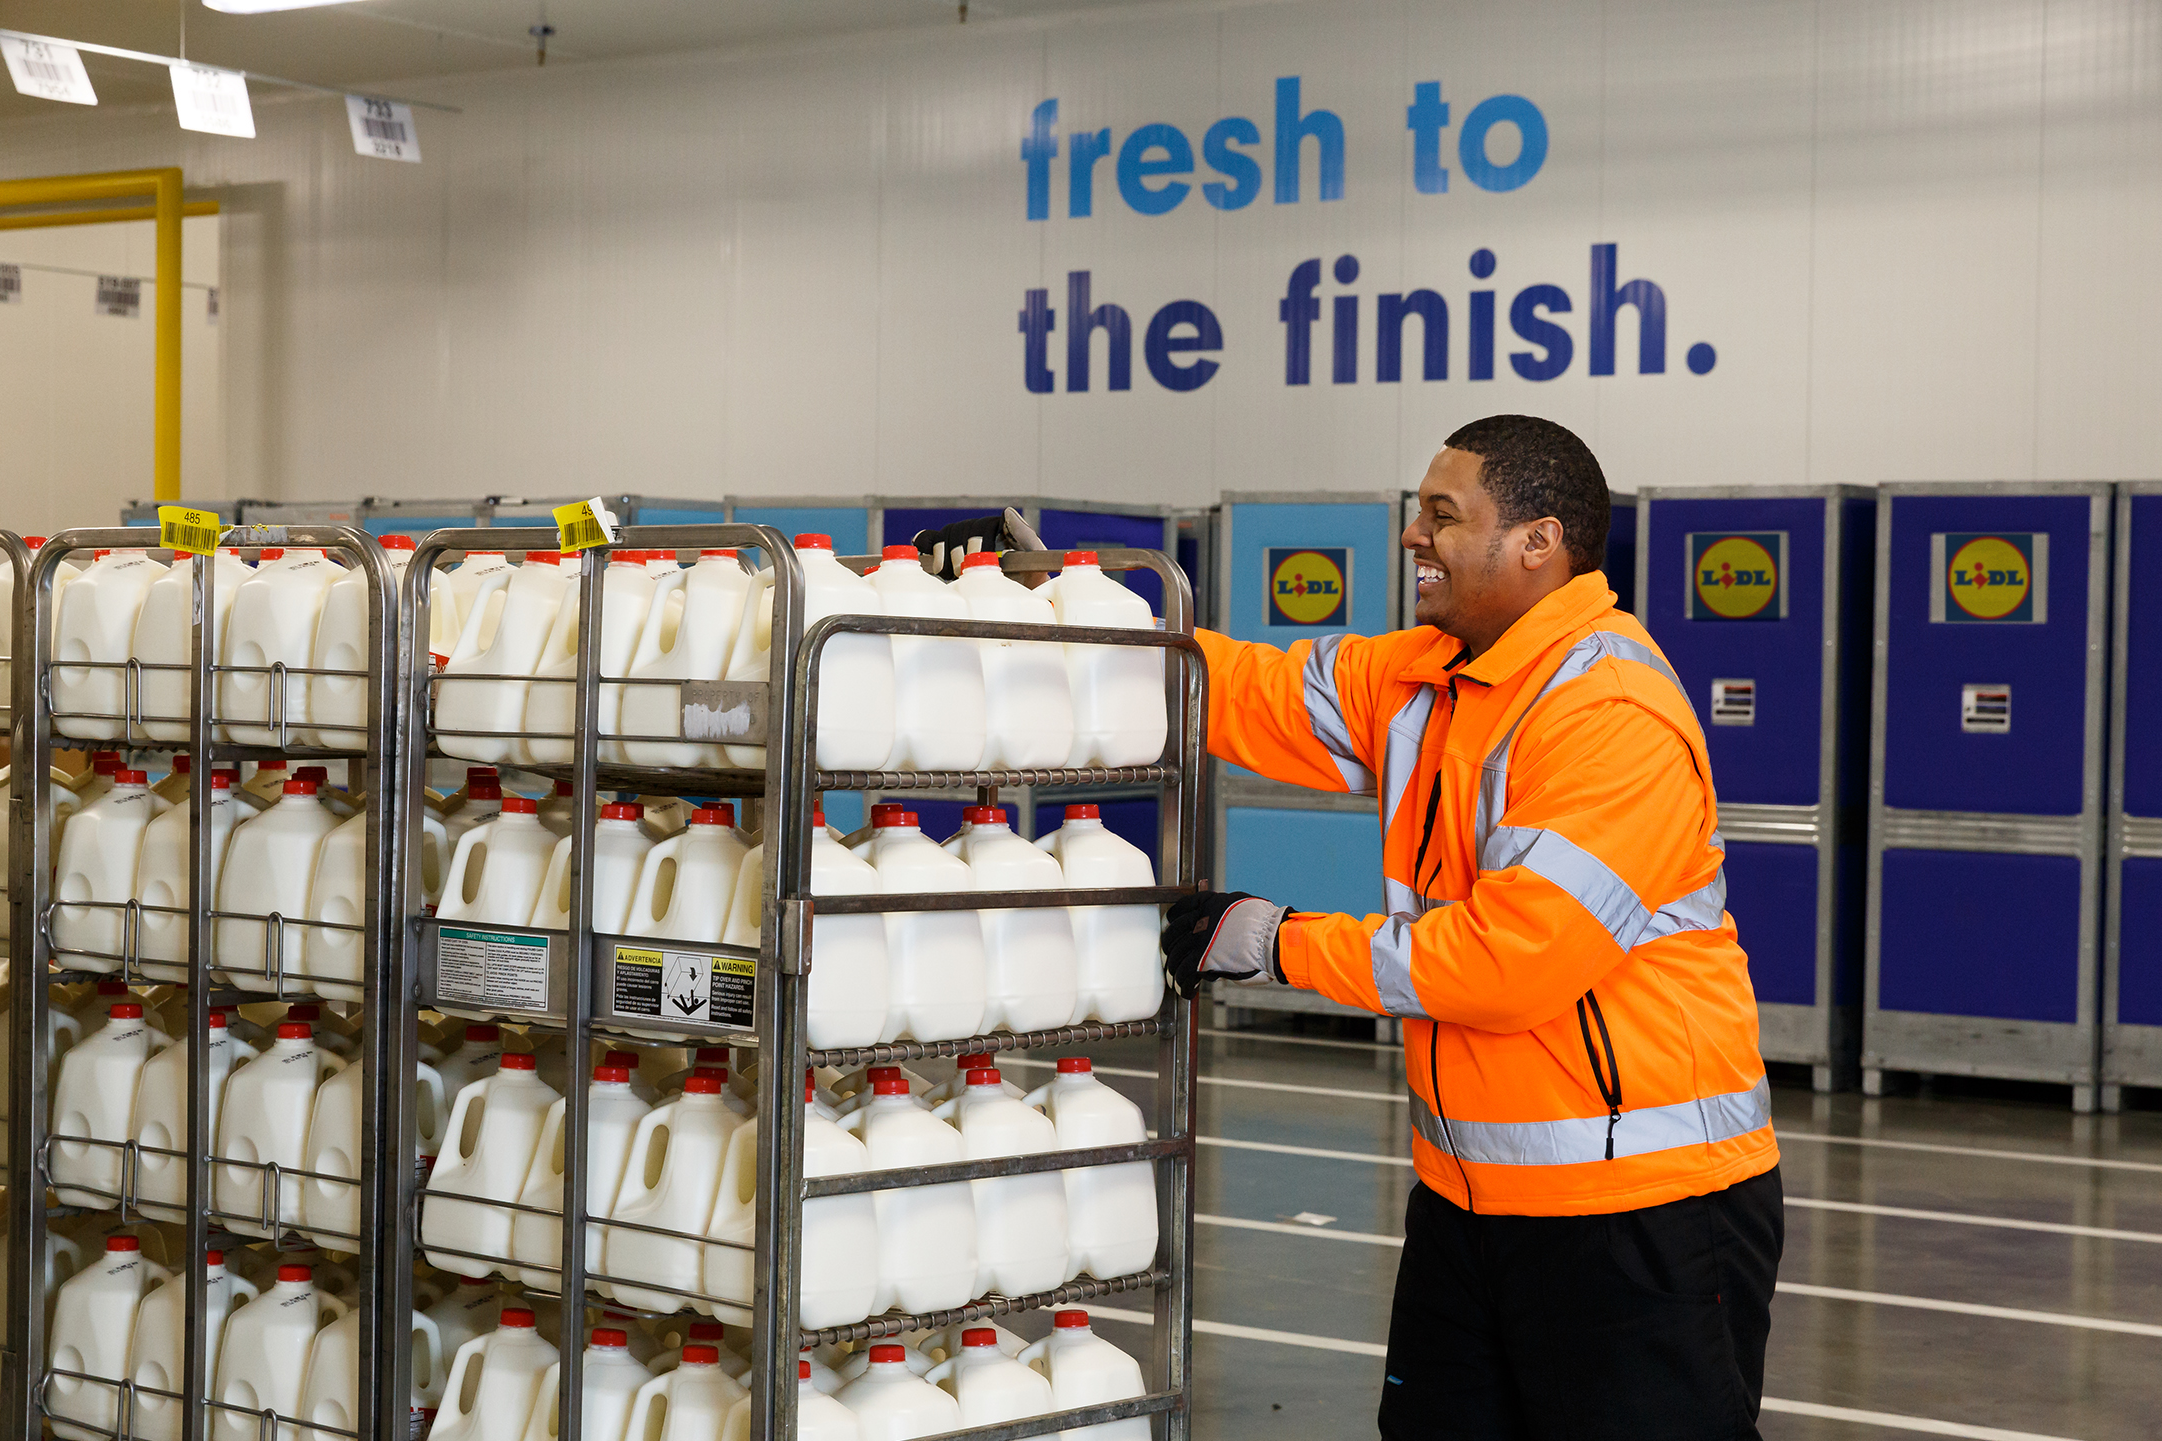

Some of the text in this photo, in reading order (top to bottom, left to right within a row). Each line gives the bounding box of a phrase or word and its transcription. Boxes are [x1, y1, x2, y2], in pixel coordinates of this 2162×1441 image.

[1020, 76, 1549, 221] fresh to
[1019, 243, 1718, 394] the finish.
[184, 512, 201, 525] 485
[466, 932, 515, 943] SAFETY INSTRUCTIONS
[625, 954, 662, 964] ADVERTENCIA
[721, 962, 753, 974] WARNING
